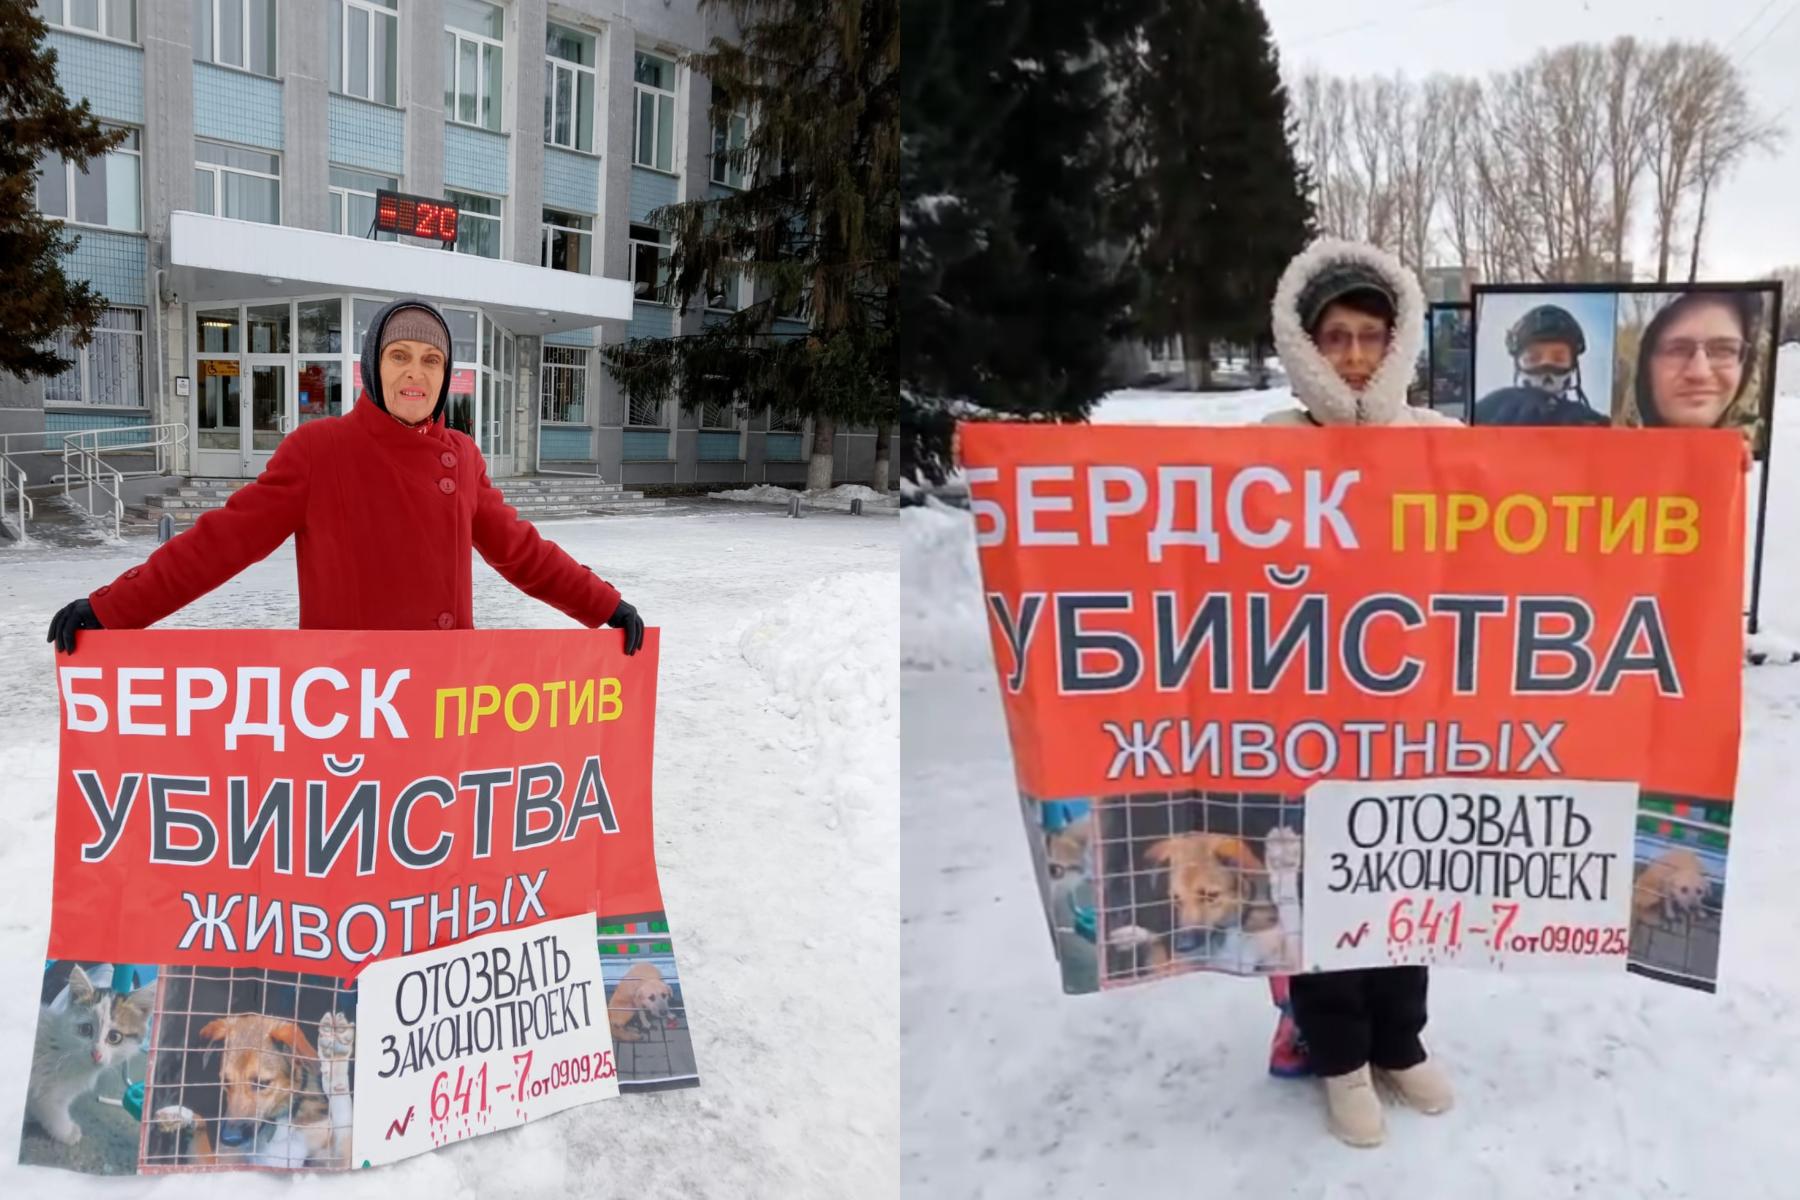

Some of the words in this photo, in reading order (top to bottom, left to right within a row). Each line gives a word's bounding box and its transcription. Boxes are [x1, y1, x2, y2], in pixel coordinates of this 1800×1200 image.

[966, 465, 1360, 562] БЕРДСК
[1391, 492, 1700, 555] ПРОТИВ
[986, 565, 1685, 697] УБИЙСТВА
[59, 666, 410, 752] БЕРДСК
[435, 677, 623, 738] ПРОТИВ
[1103, 719, 1566, 781] ЖИВОТНЫХ
[72, 754, 621, 878] УБИЙСТВА
[1347, 793, 1592, 848] ОТОЗВАТЬ
[176, 868, 549, 964] ЖИВОТНЫХ
[1327, 848, 1618, 900] ЗАКОНОПРОЕКТ
[395, 935, 572, 1027] ОТОЗВАТЬ
[1511, 936, 1539, 953] от
[377, 980, 592, 1079] ЗАКОНОПРОЕКТ
[531, 1077, 550, 1097] от
